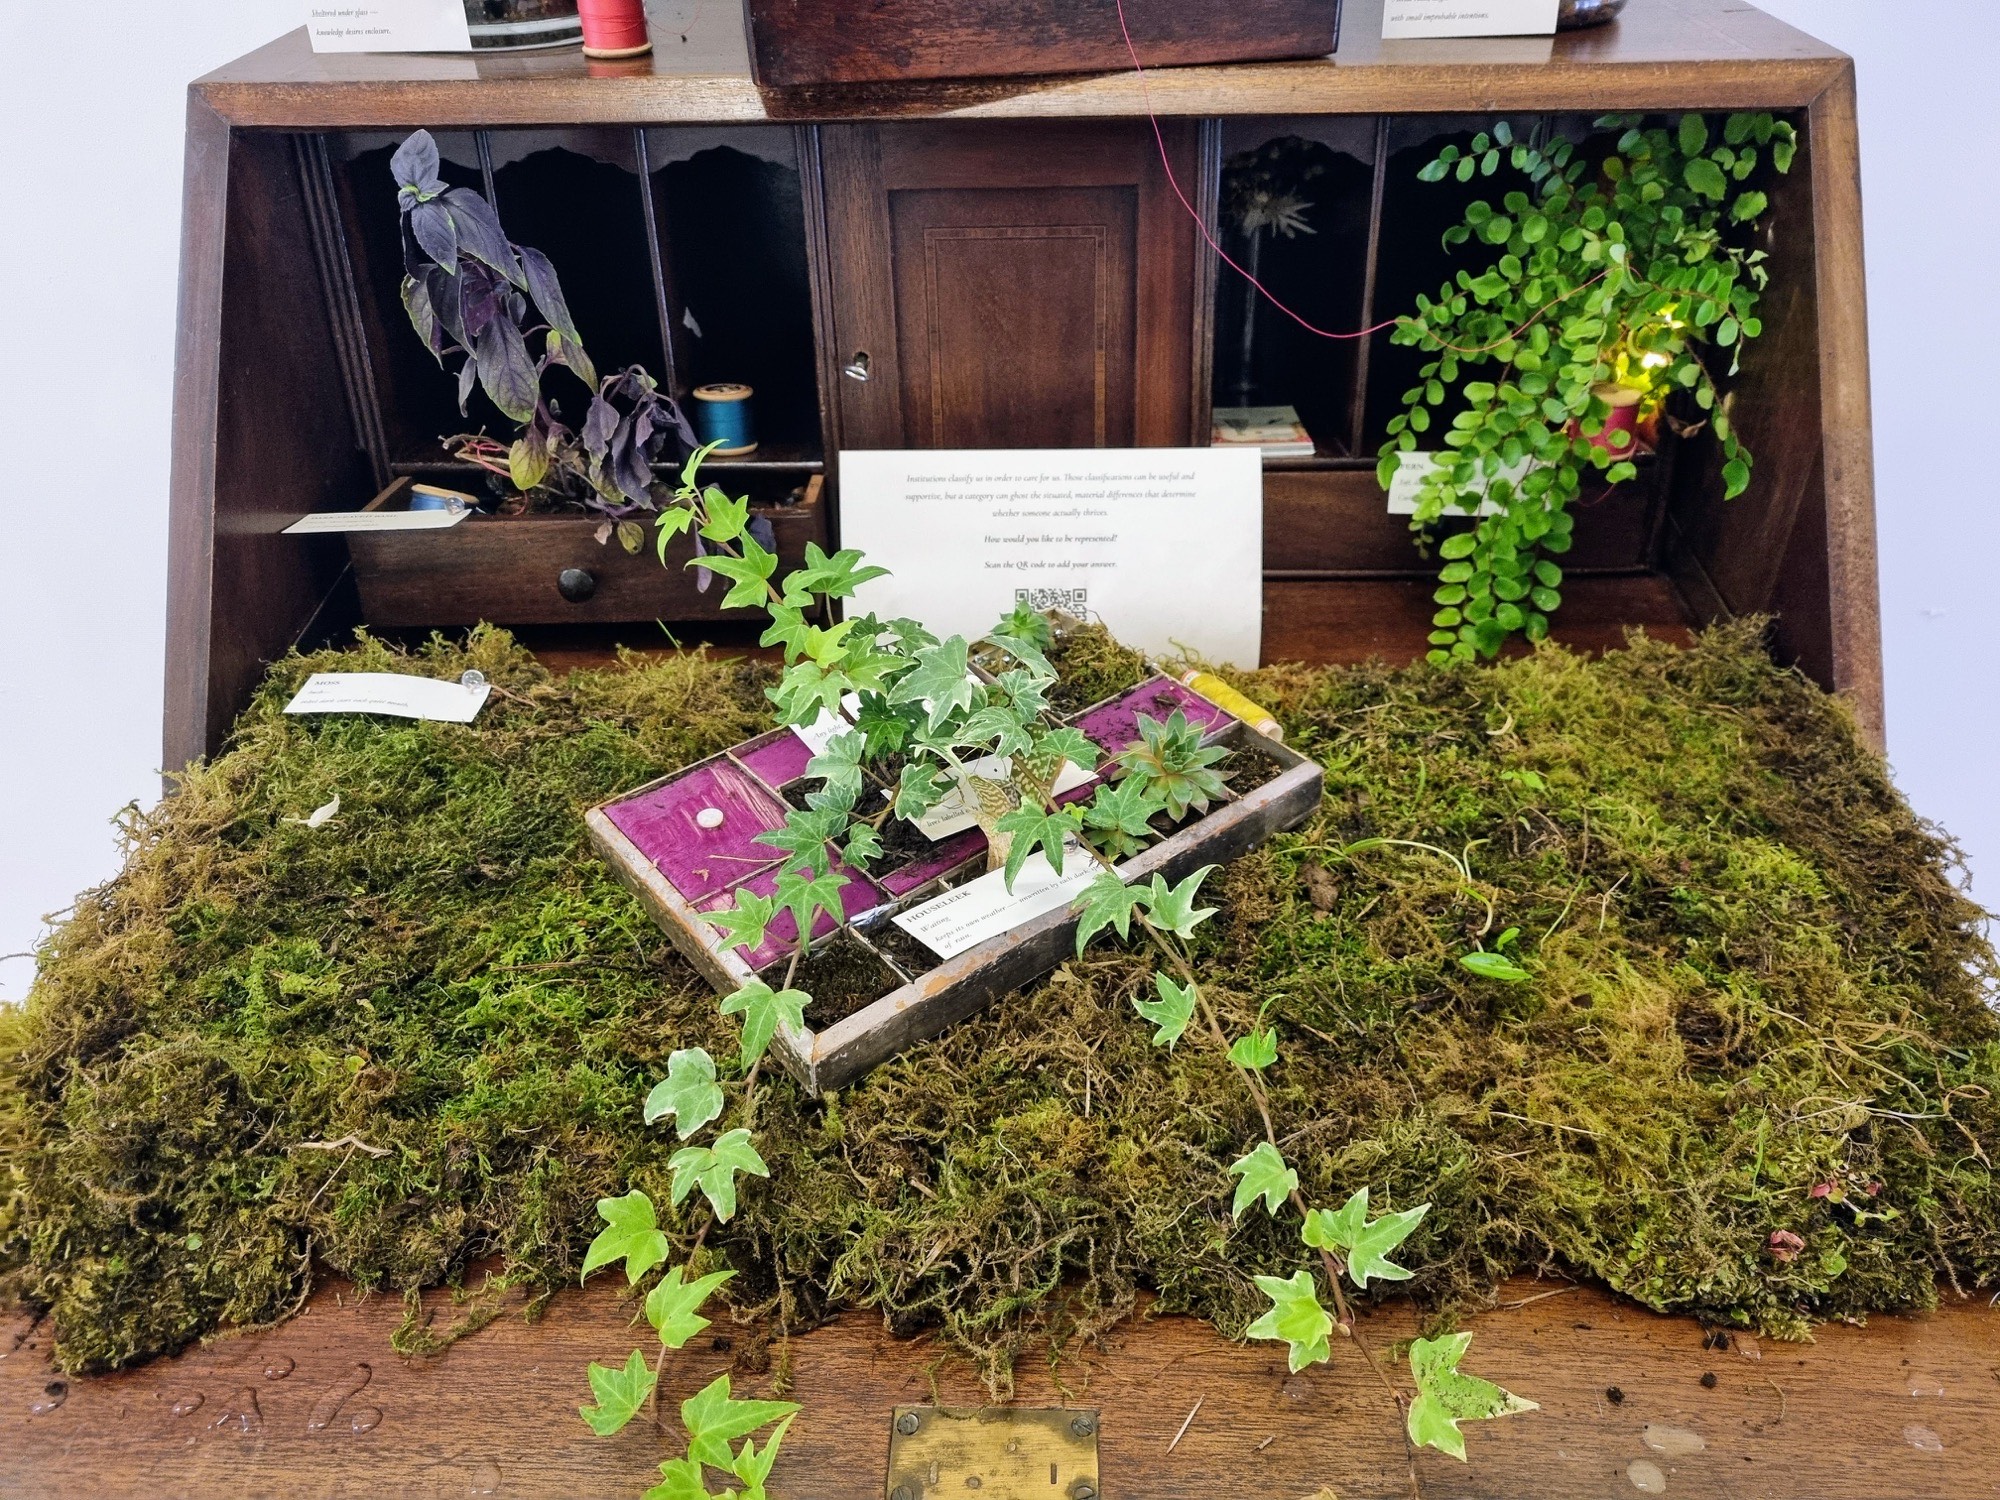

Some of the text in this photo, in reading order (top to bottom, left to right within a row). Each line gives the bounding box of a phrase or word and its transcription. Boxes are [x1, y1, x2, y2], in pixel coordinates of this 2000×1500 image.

[355, 9, 368, 18] glass
[316, 28, 344, 38] knowledge
[346, 27, 363, 35] desires
[907, 474, 947, 482] Institutions
[948, 474, 973, 484] classify
[985, 474, 993, 482] in
[995, 474, 1012, 482] order
[1040, 474, 1050, 483] for
[1064, 473, 1083, 481] Those
[1085, 473, 1132, 483] classifications
[1149, 472, 1157, 480] be
[1159, 472, 1180, 483] useful
[1181, 472, 1195, 480] and
[906, 493, 943, 502] supportive,
[945, 492, 956, 500] but
[965, 494, 994, 502] category
[1010, 492, 1028, 502] ghost
[1030, 491, 1041, 500] the
[1043, 491, 1073, 500] situated,
[1075, 491, 1105, 499] material
[1107, 491, 1143, 501] differences
[1145, 490, 1159, 498] that
[1161, 490, 1196, 498] determine
[992, 509, 1020, 517] whether
[1053, 509, 1081, 518] actually
[984, 535, 1001, 543] How
[1003, 535, 1024, 543] would
[1025, 537, 1040, 545] you
[1041, 534, 1054, 542] like
[1065, 534, 1073, 542] be
[1075, 534, 1118, 544] represented?
[984, 561, 1001, 569] Scan
[1016, 561, 1029, 570] QR
[1057, 560, 1070, 568] add
[1071, 562, 1089, 570] your
[941, 810, 965, 821] labelled
[906, 890, 972, 923] HOUSELEEK
[935, 930, 954, 942] keeps
[955, 925, 964, 933] its
[965, 919, 980, 927] own
[981, 906, 1006, 921] weather
[1050, 881, 1059, 890] by
[1060, 877, 1072, 885] each
[1074, 870, 1088, 879] dark
[920, 916, 951, 932] Waiting
